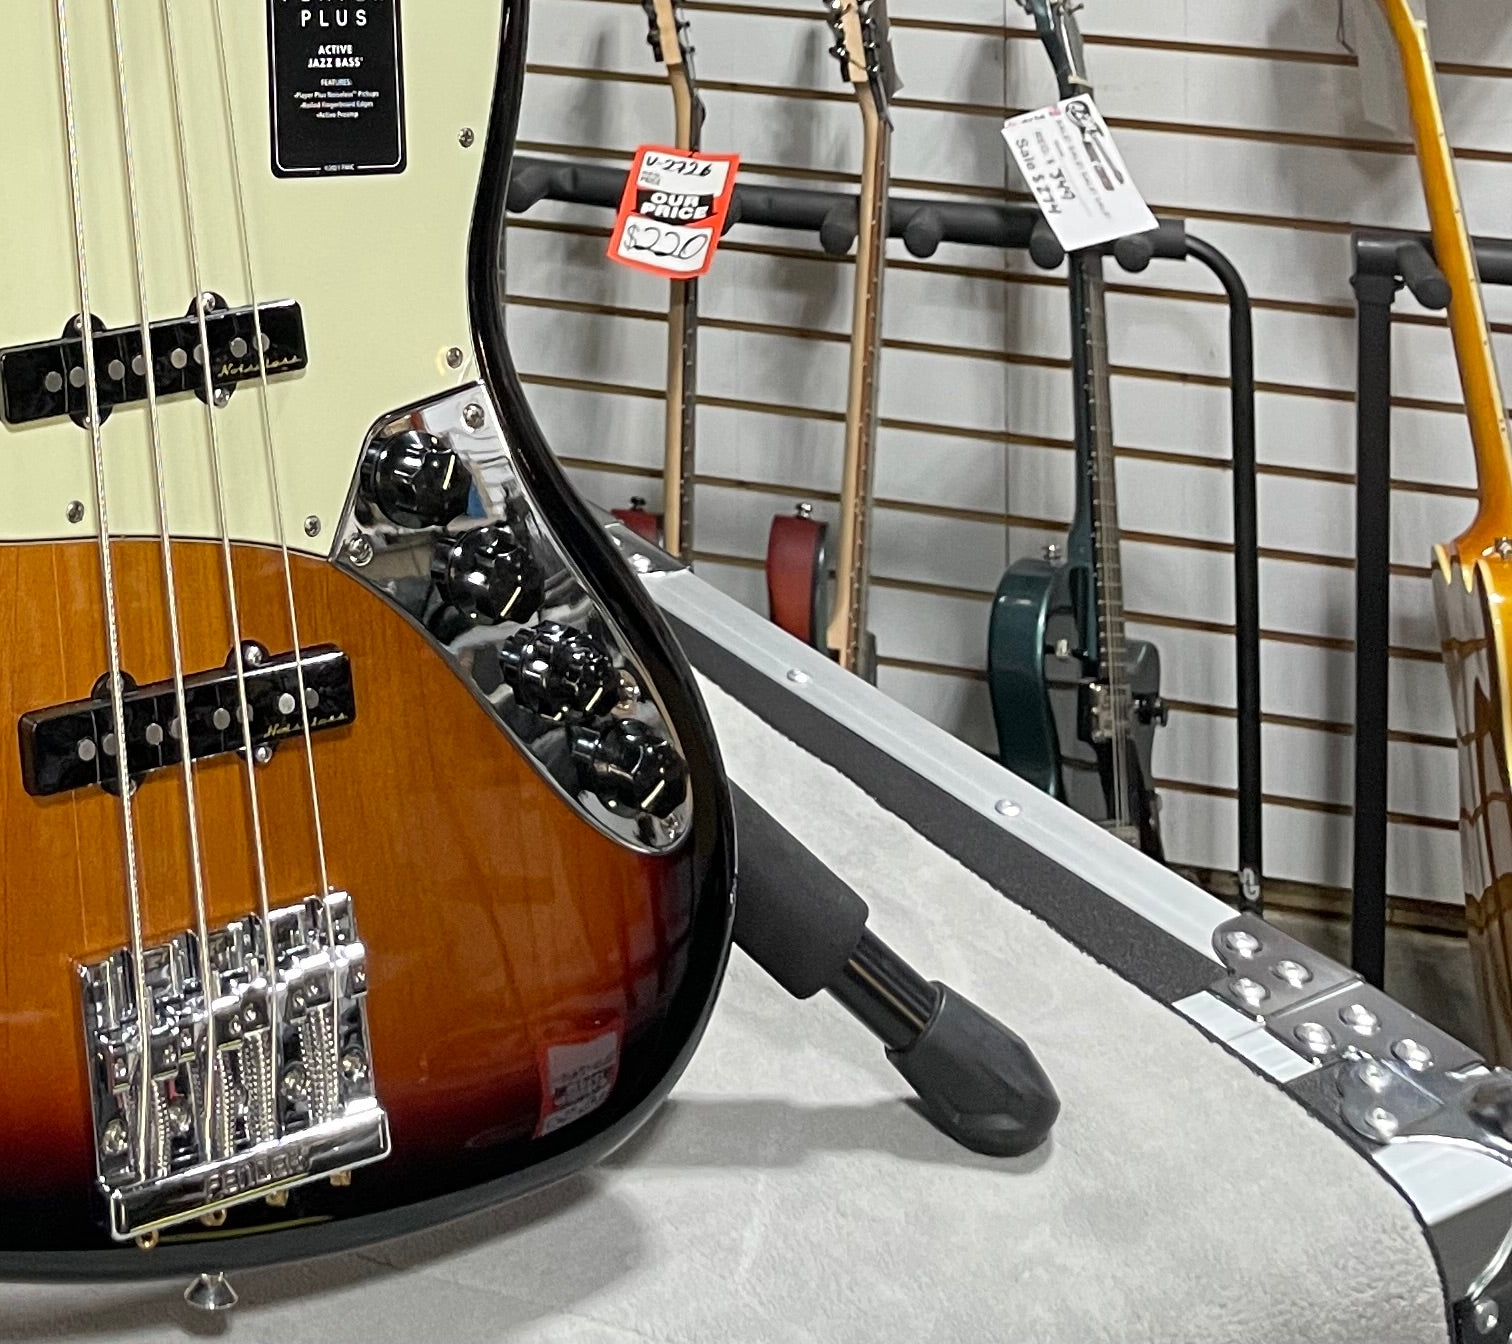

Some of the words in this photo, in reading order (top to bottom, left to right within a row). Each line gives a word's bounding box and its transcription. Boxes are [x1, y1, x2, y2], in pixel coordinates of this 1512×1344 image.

[300, 9, 368, 27] PLUS
[317, 44, 353, 55] ACTIVE
[307, 57, 333, 68] JAZZ
[1015, 137, 1037, 171] Sale
[650, 192, 700, 208] OUR
[639, 202, 710, 220] PRICE
[624, 224, 709, 260] $220
